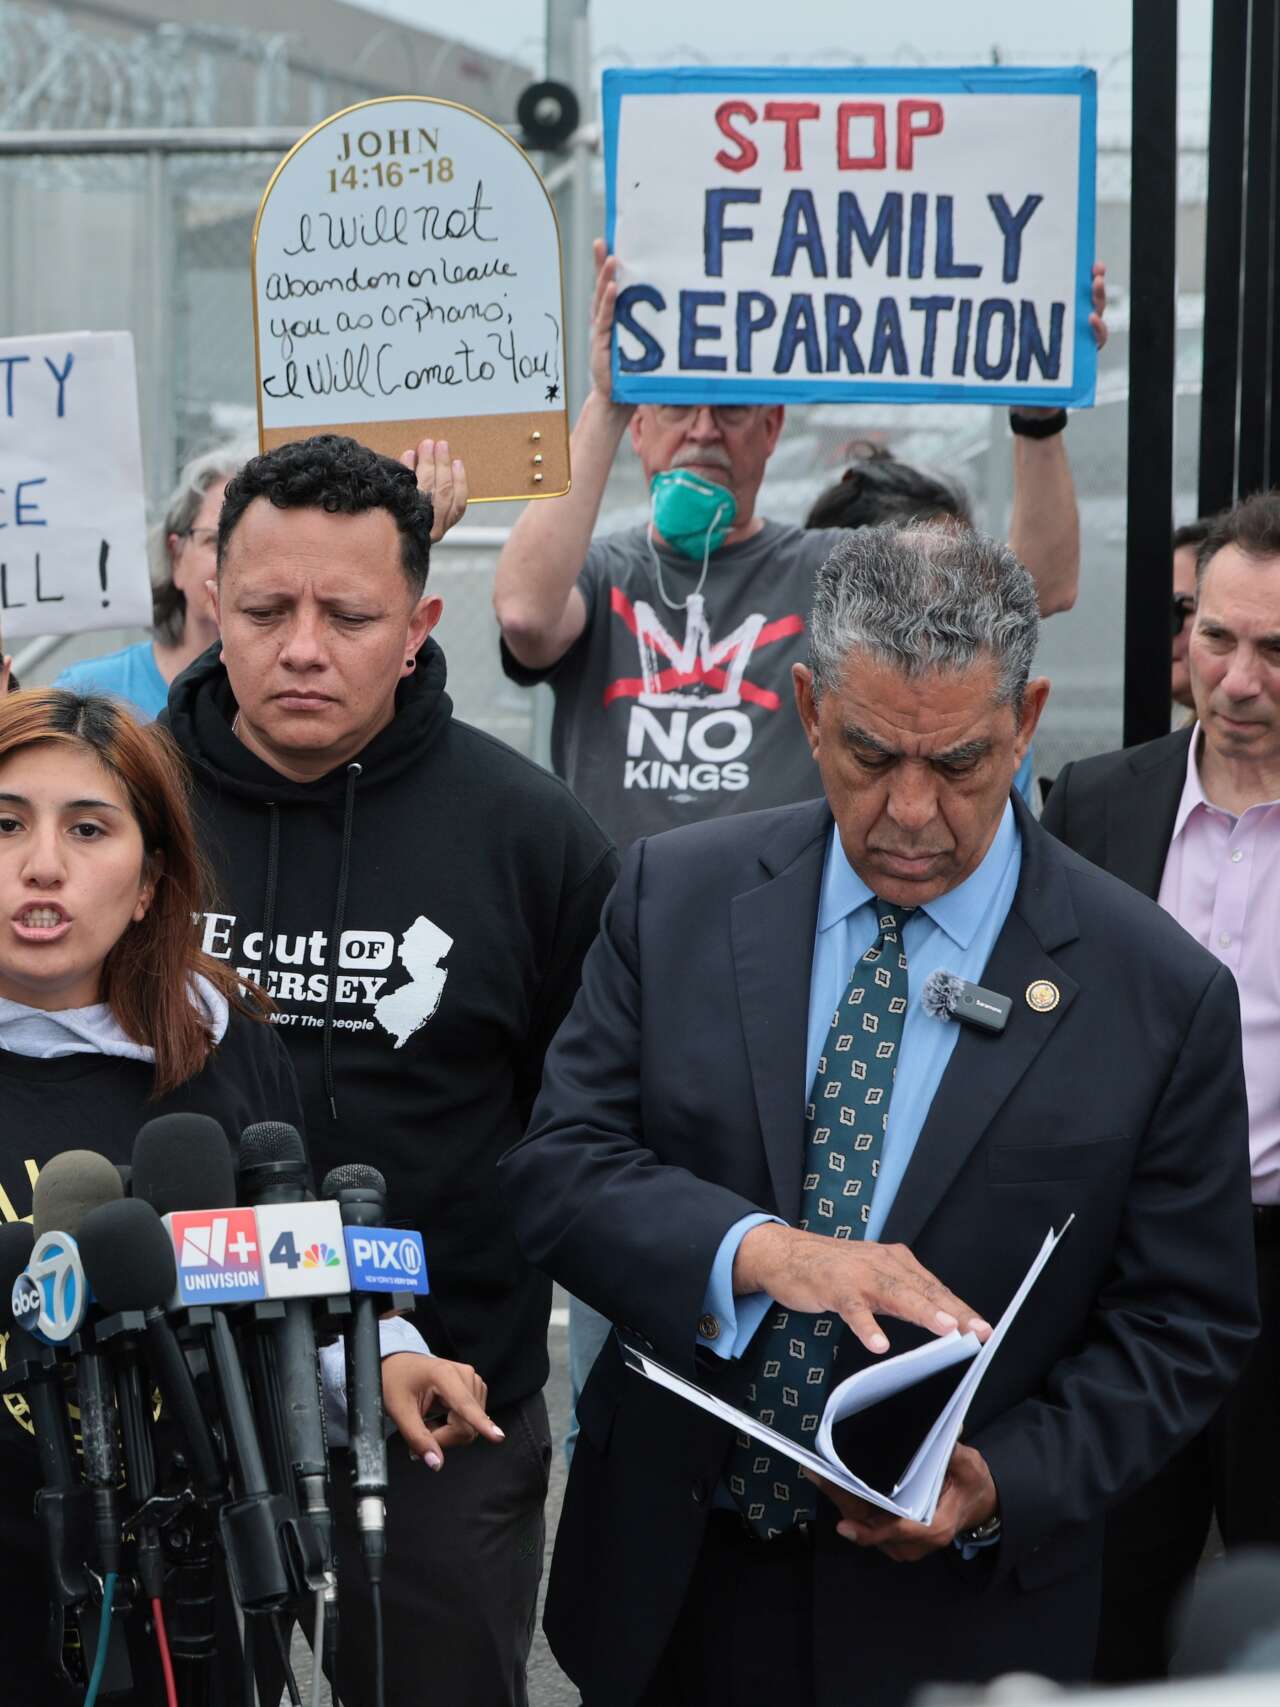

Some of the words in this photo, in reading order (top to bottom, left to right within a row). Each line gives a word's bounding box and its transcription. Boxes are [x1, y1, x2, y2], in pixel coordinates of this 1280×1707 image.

[337, 127, 441, 161] JOHN
[714, 100, 945, 173] STOP
[327, 156, 455, 193] 14:16-18
[704, 188, 1044, 284] FAMILY
[270, 317, 330, 361] you
[336, 311, 374, 333] as
[614, 284, 1066, 381] SEPARATION
[0, 553, 64, 610] LL
[627, 705, 752, 763] NO
[623, 760, 749, 791] KINGS
[242, 930, 328, 966] out
[344, 940, 385, 960] OF
[269, 1012, 299, 1025] NOT
[301, 1015, 325, 1028] The
[268, 1231, 301, 1270] 4
[184, 1270, 260, 1291] UNIVISION
[12, 1289, 40, 1317] abc
